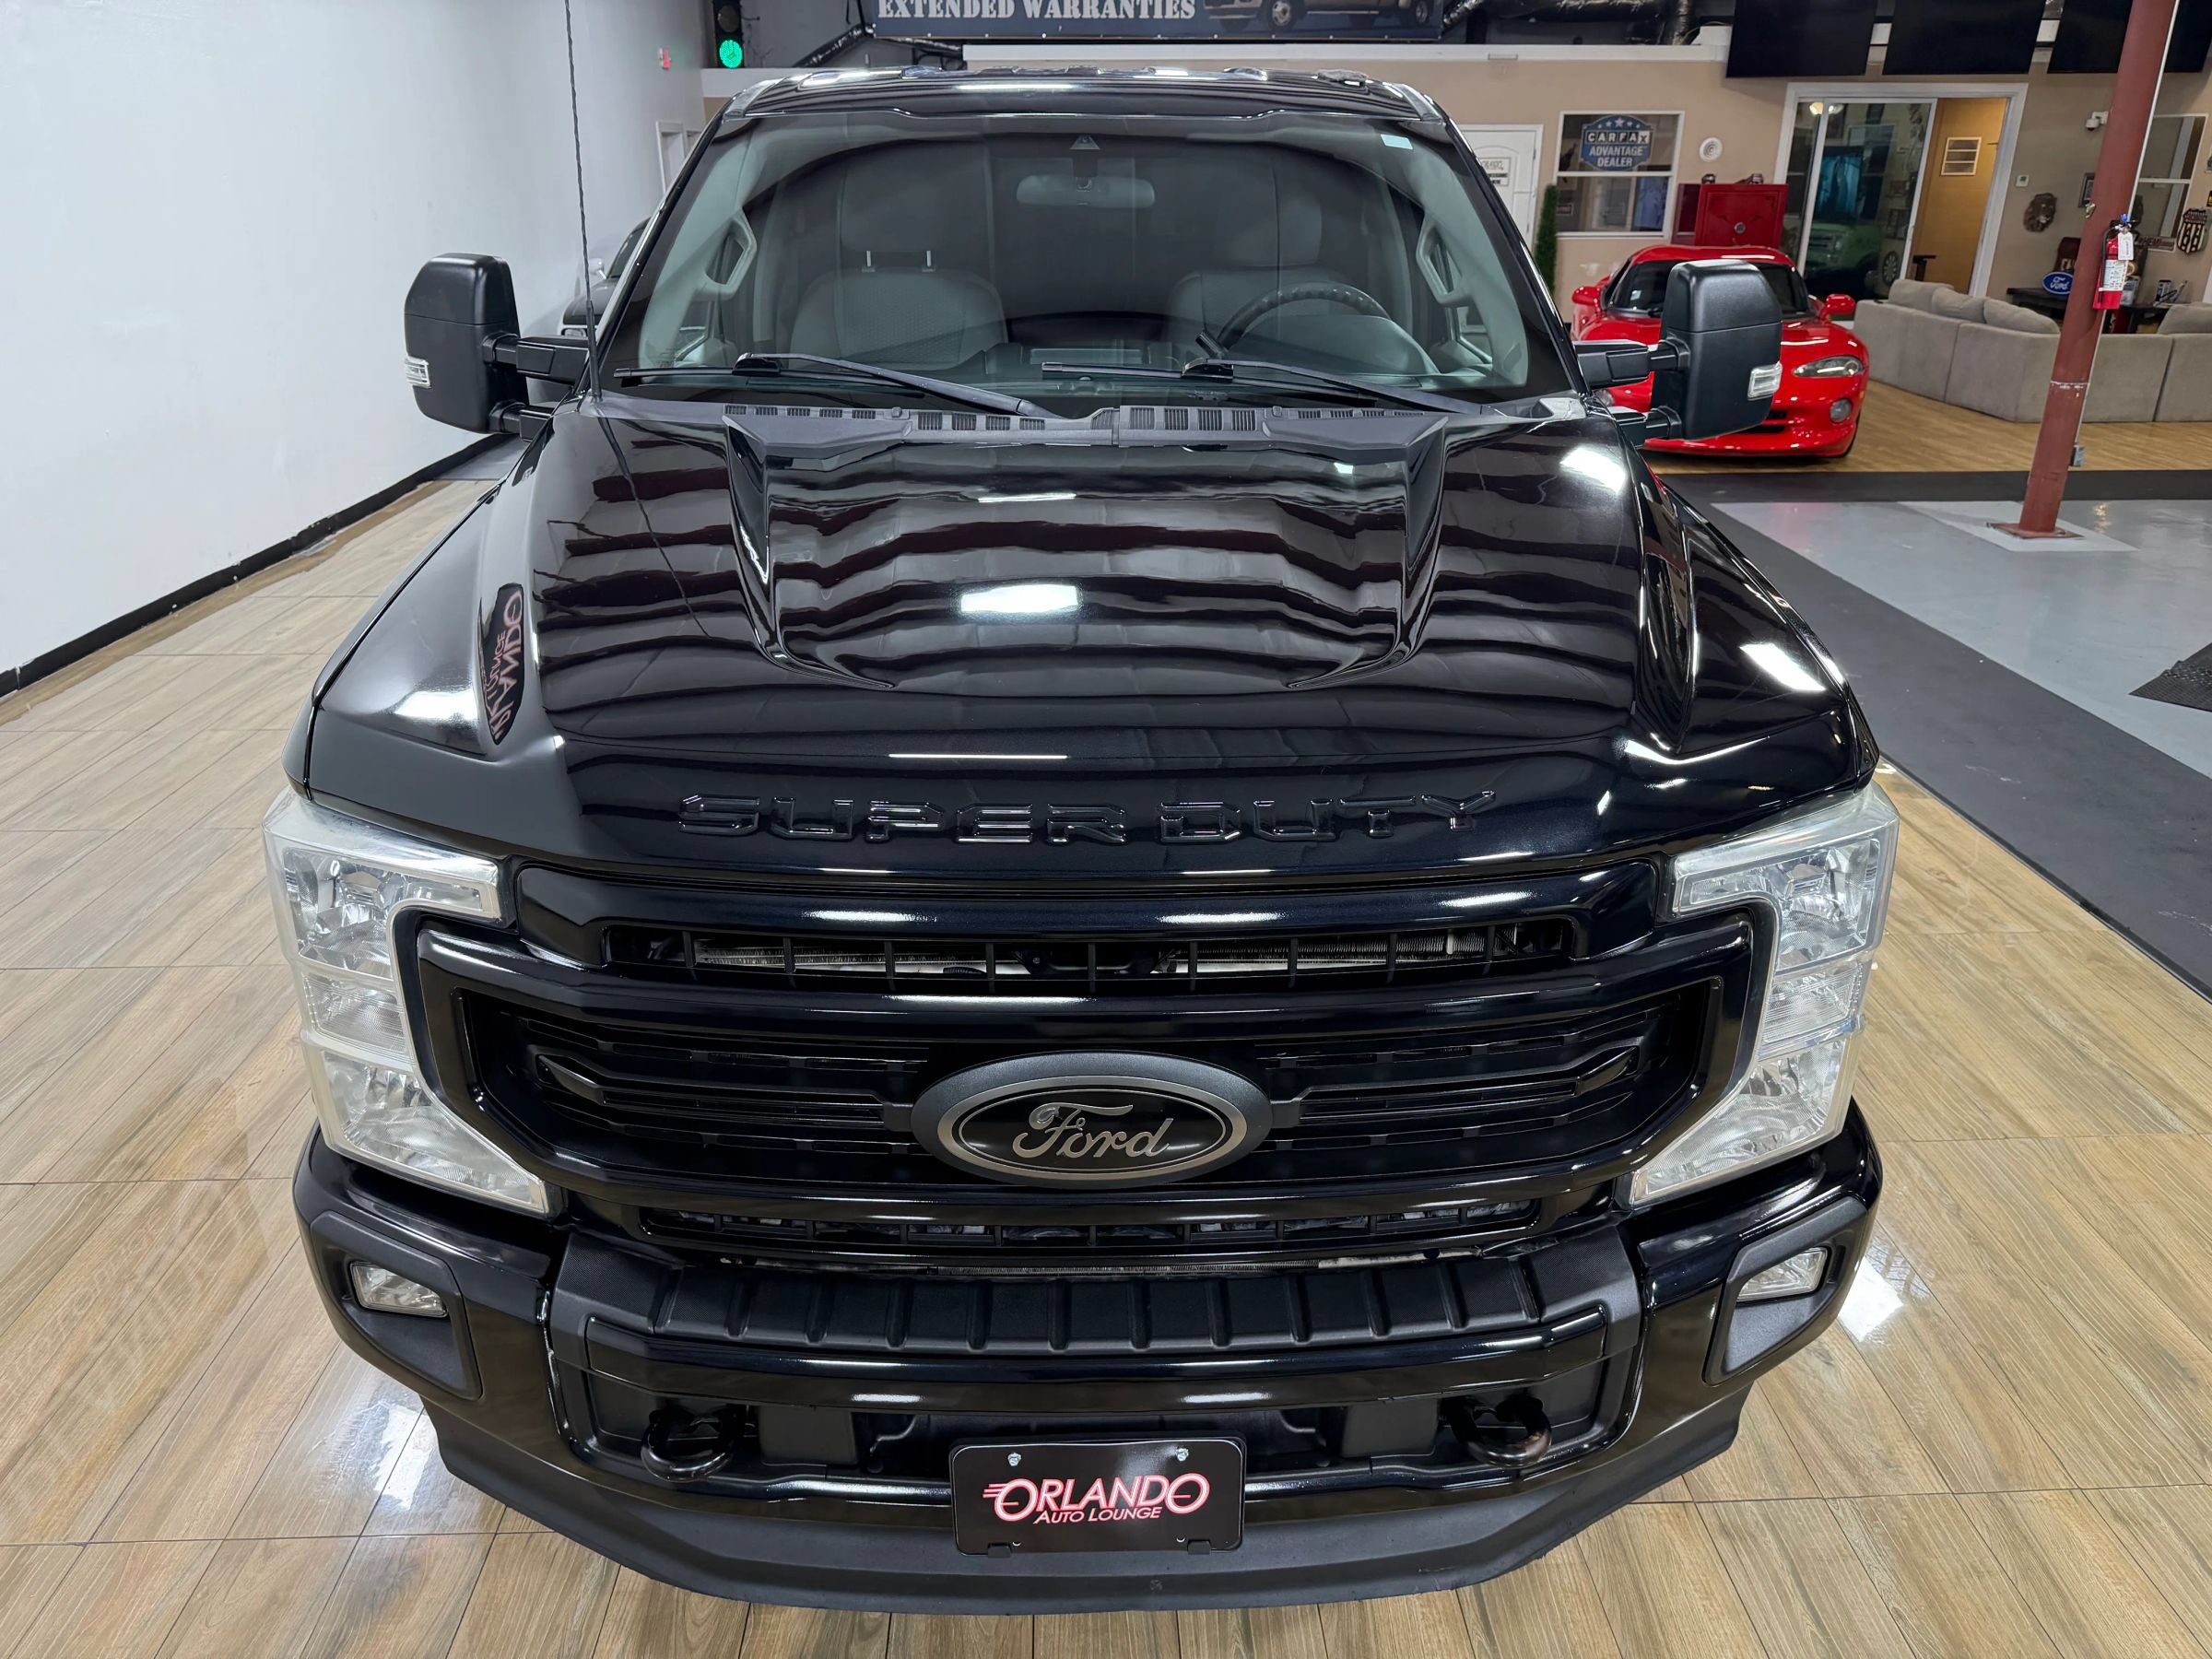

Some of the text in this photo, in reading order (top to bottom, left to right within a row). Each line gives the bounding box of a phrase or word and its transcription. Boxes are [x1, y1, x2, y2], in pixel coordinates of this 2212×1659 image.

[877, 0, 1196, 19] EXTENDED WARRANTIES
[1587, 131, 1650, 144] CARFAX
[1589, 146, 1643, 156] ADVANTAGE
[1597, 157, 1633, 167] DEALER
[2050, 276, 2070, 290] Ford
[677, 789, 1496, 845] SUPER DUTY
[1012, 1102, 1174, 1159] Ford
[982, 1473, 1210, 1522] ORLANDO
[1033, 1506, 1163, 1524] AUTO LOUNGE
